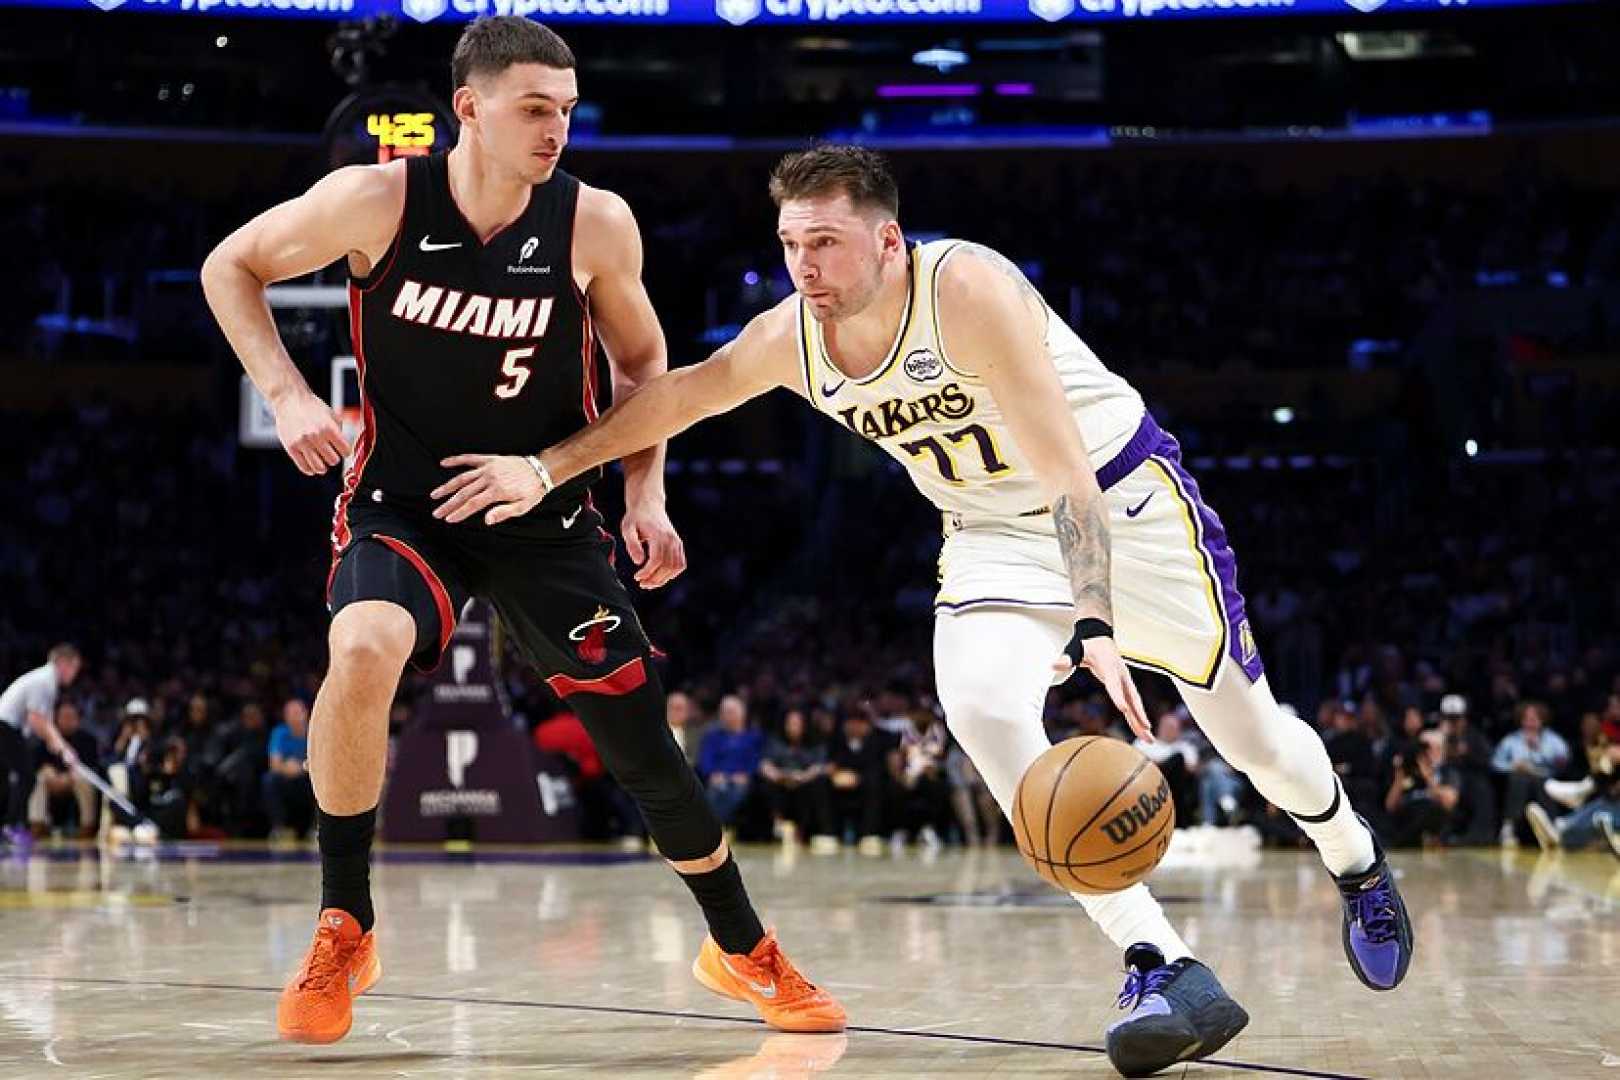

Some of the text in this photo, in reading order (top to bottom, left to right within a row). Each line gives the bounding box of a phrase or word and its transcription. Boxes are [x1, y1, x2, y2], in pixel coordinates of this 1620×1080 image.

[391, 279, 554, 338] MIAMI
[494, 345, 537, 400] 5
[837, 383, 975, 438] LAKERS
[899, 423, 1012, 484] 77
[1100, 778, 1169, 844] Wilso
